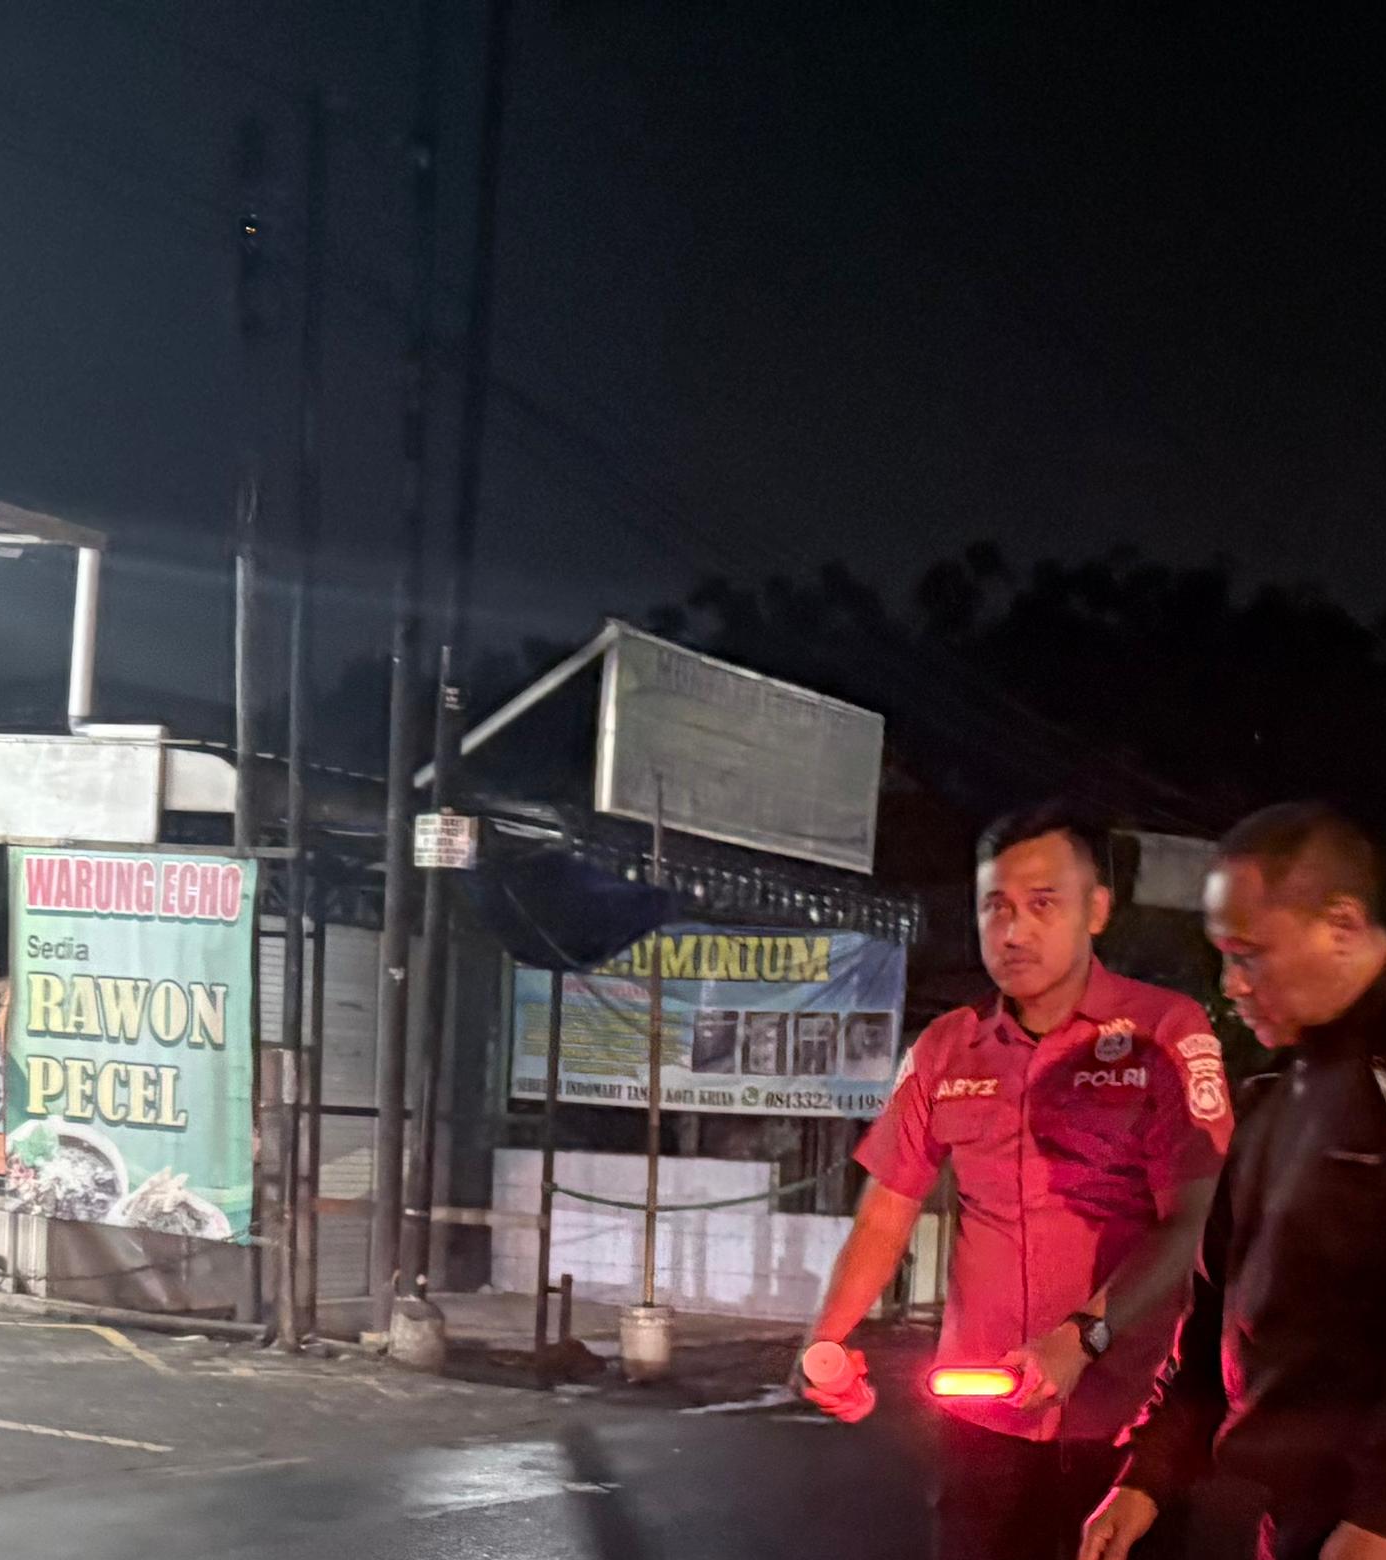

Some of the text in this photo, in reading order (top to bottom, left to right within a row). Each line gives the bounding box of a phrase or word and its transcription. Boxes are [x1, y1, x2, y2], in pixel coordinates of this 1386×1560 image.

[24, 855, 242, 921] WARUNG ECHO
[27, 935, 90, 961] Sedia
[592, 933, 830, 981] UMINIUM
[26, 972, 228, 1048] RAWON
[25, 1055, 188, 1129] PECEL
[1074, 1067, 1147, 1088] POLRI
